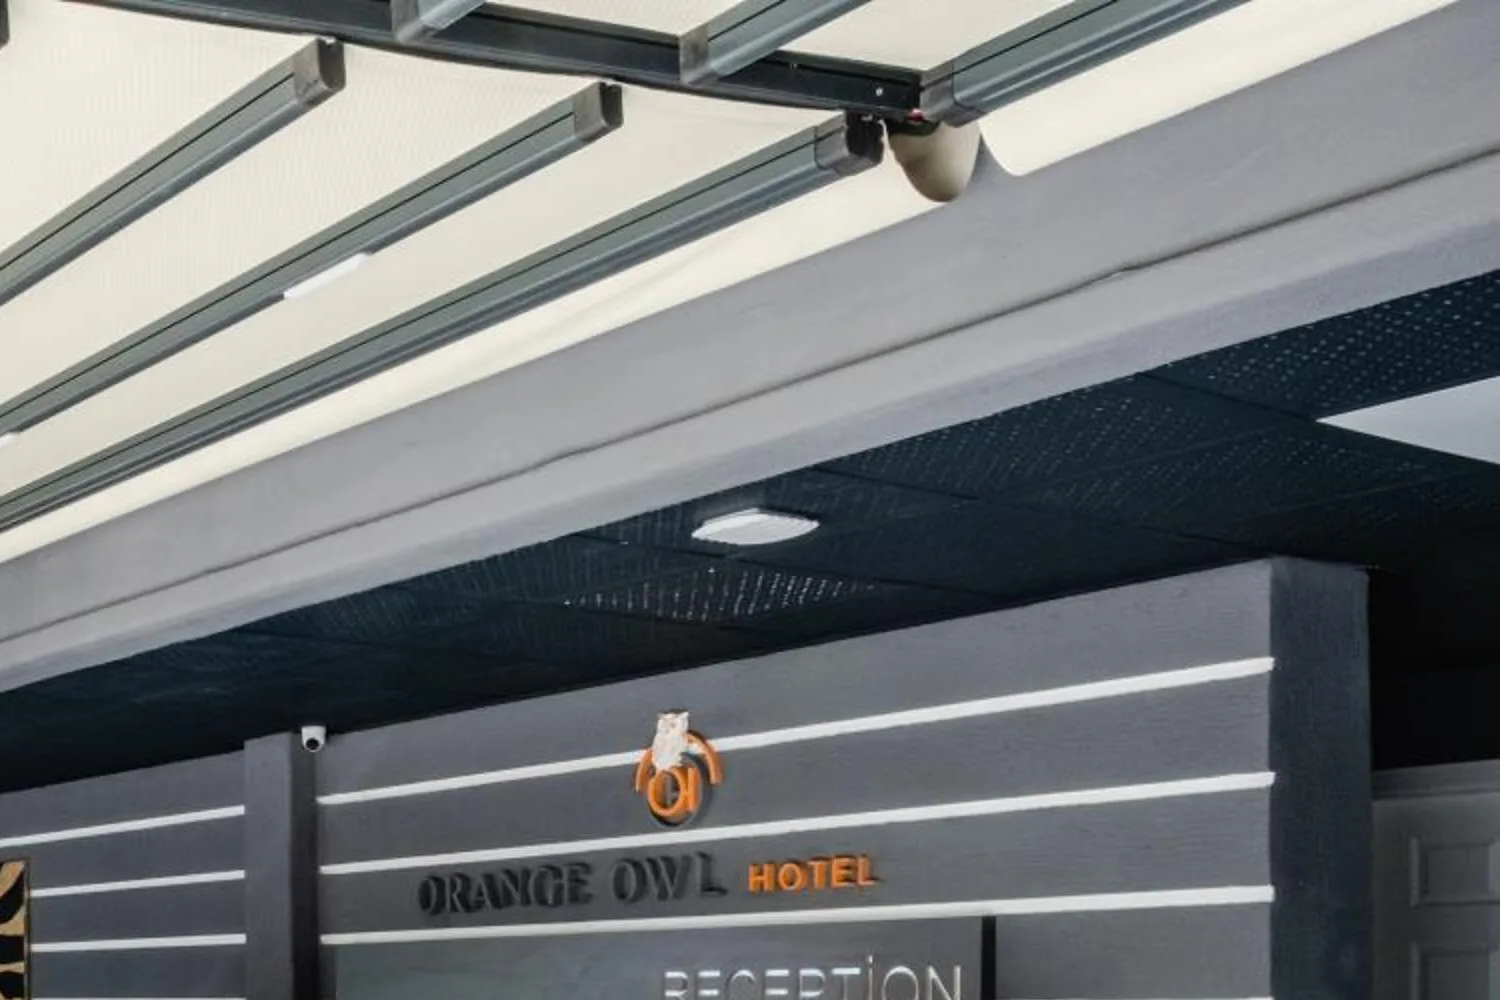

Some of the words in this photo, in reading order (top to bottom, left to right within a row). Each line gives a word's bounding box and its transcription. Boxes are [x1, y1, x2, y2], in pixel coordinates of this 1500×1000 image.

[417, 861, 595, 916] ORANGE
[611, 851, 729, 903] OWL
[748, 854, 879, 893] HOTEL
